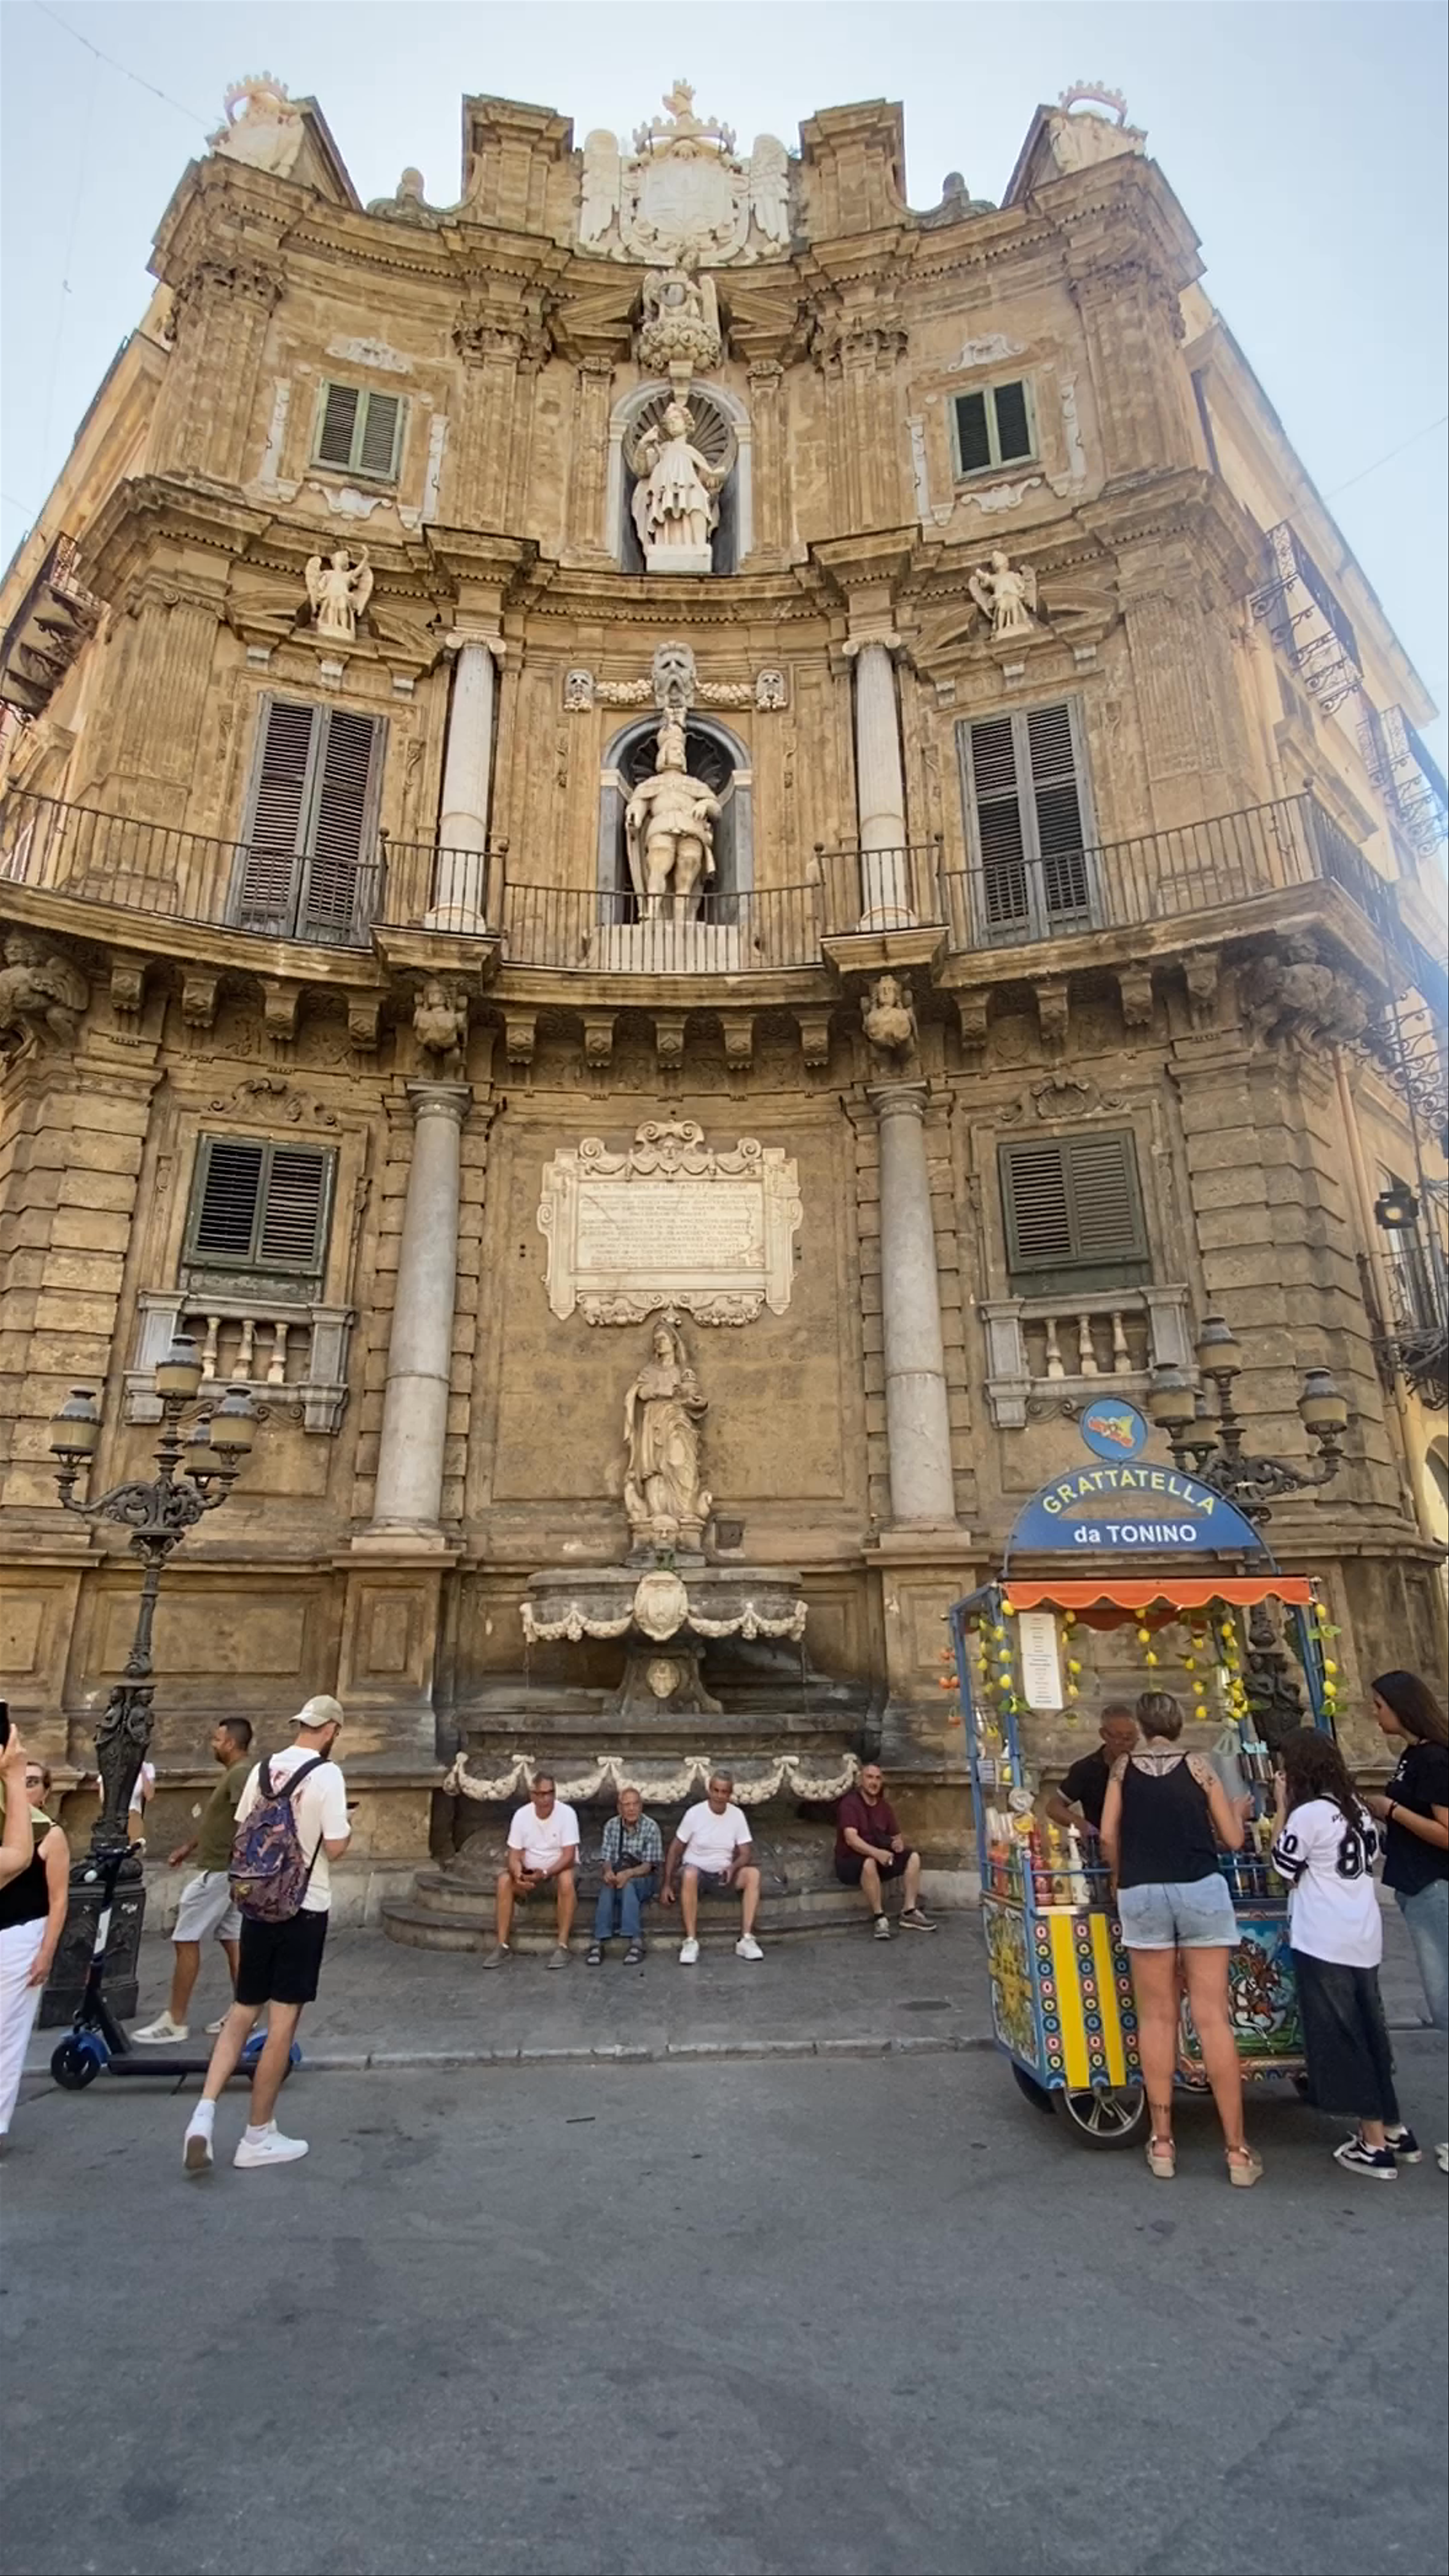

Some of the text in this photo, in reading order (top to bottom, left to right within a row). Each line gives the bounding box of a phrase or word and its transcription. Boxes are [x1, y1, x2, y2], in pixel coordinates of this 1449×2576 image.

[1043, 1469, 1214, 1515] GRATTATELLA
[1074, 1525, 1197, 1543] da TONINO
